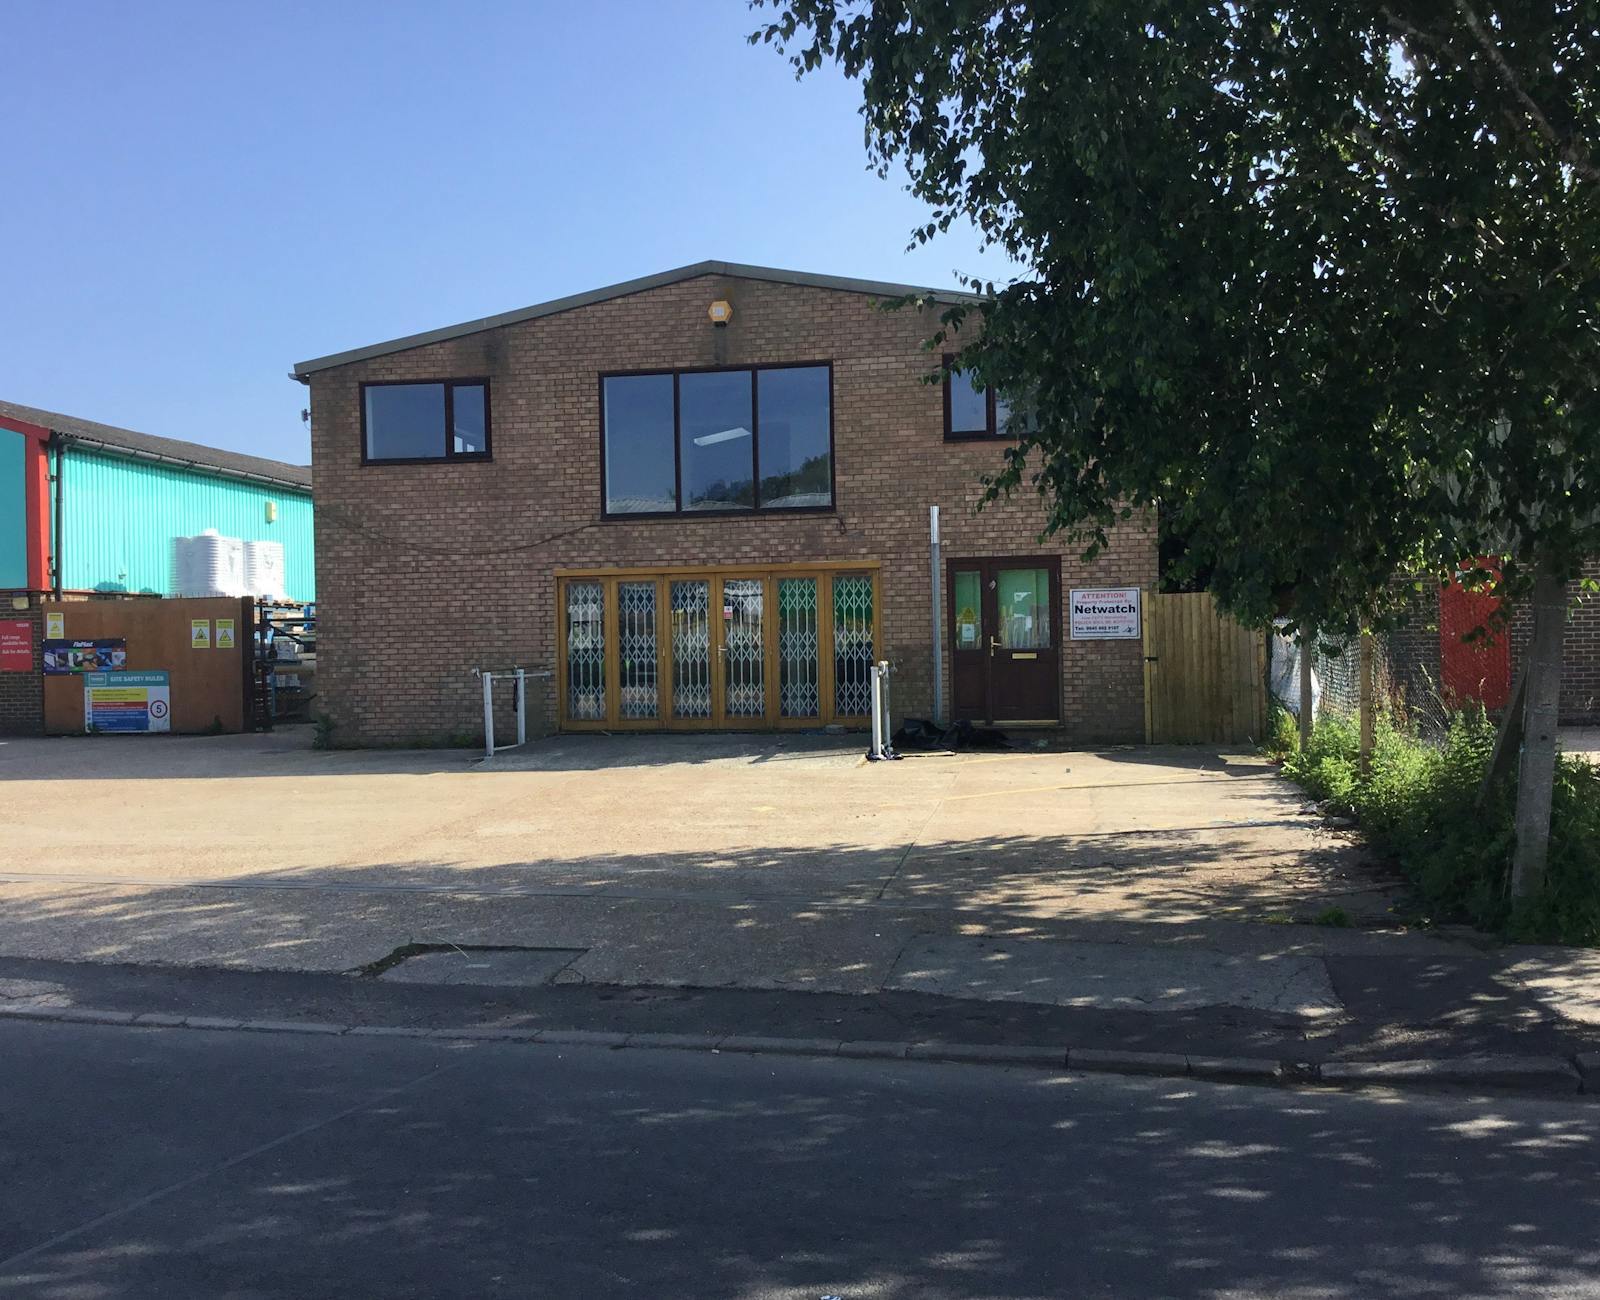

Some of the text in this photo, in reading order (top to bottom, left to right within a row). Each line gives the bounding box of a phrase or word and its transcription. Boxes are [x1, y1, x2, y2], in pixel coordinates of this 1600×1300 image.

[1081, 592, 1127, 600] ATTENTION!
[1074, 604, 1136, 614] Netwatch
[156, 704, 162, 714] 5
